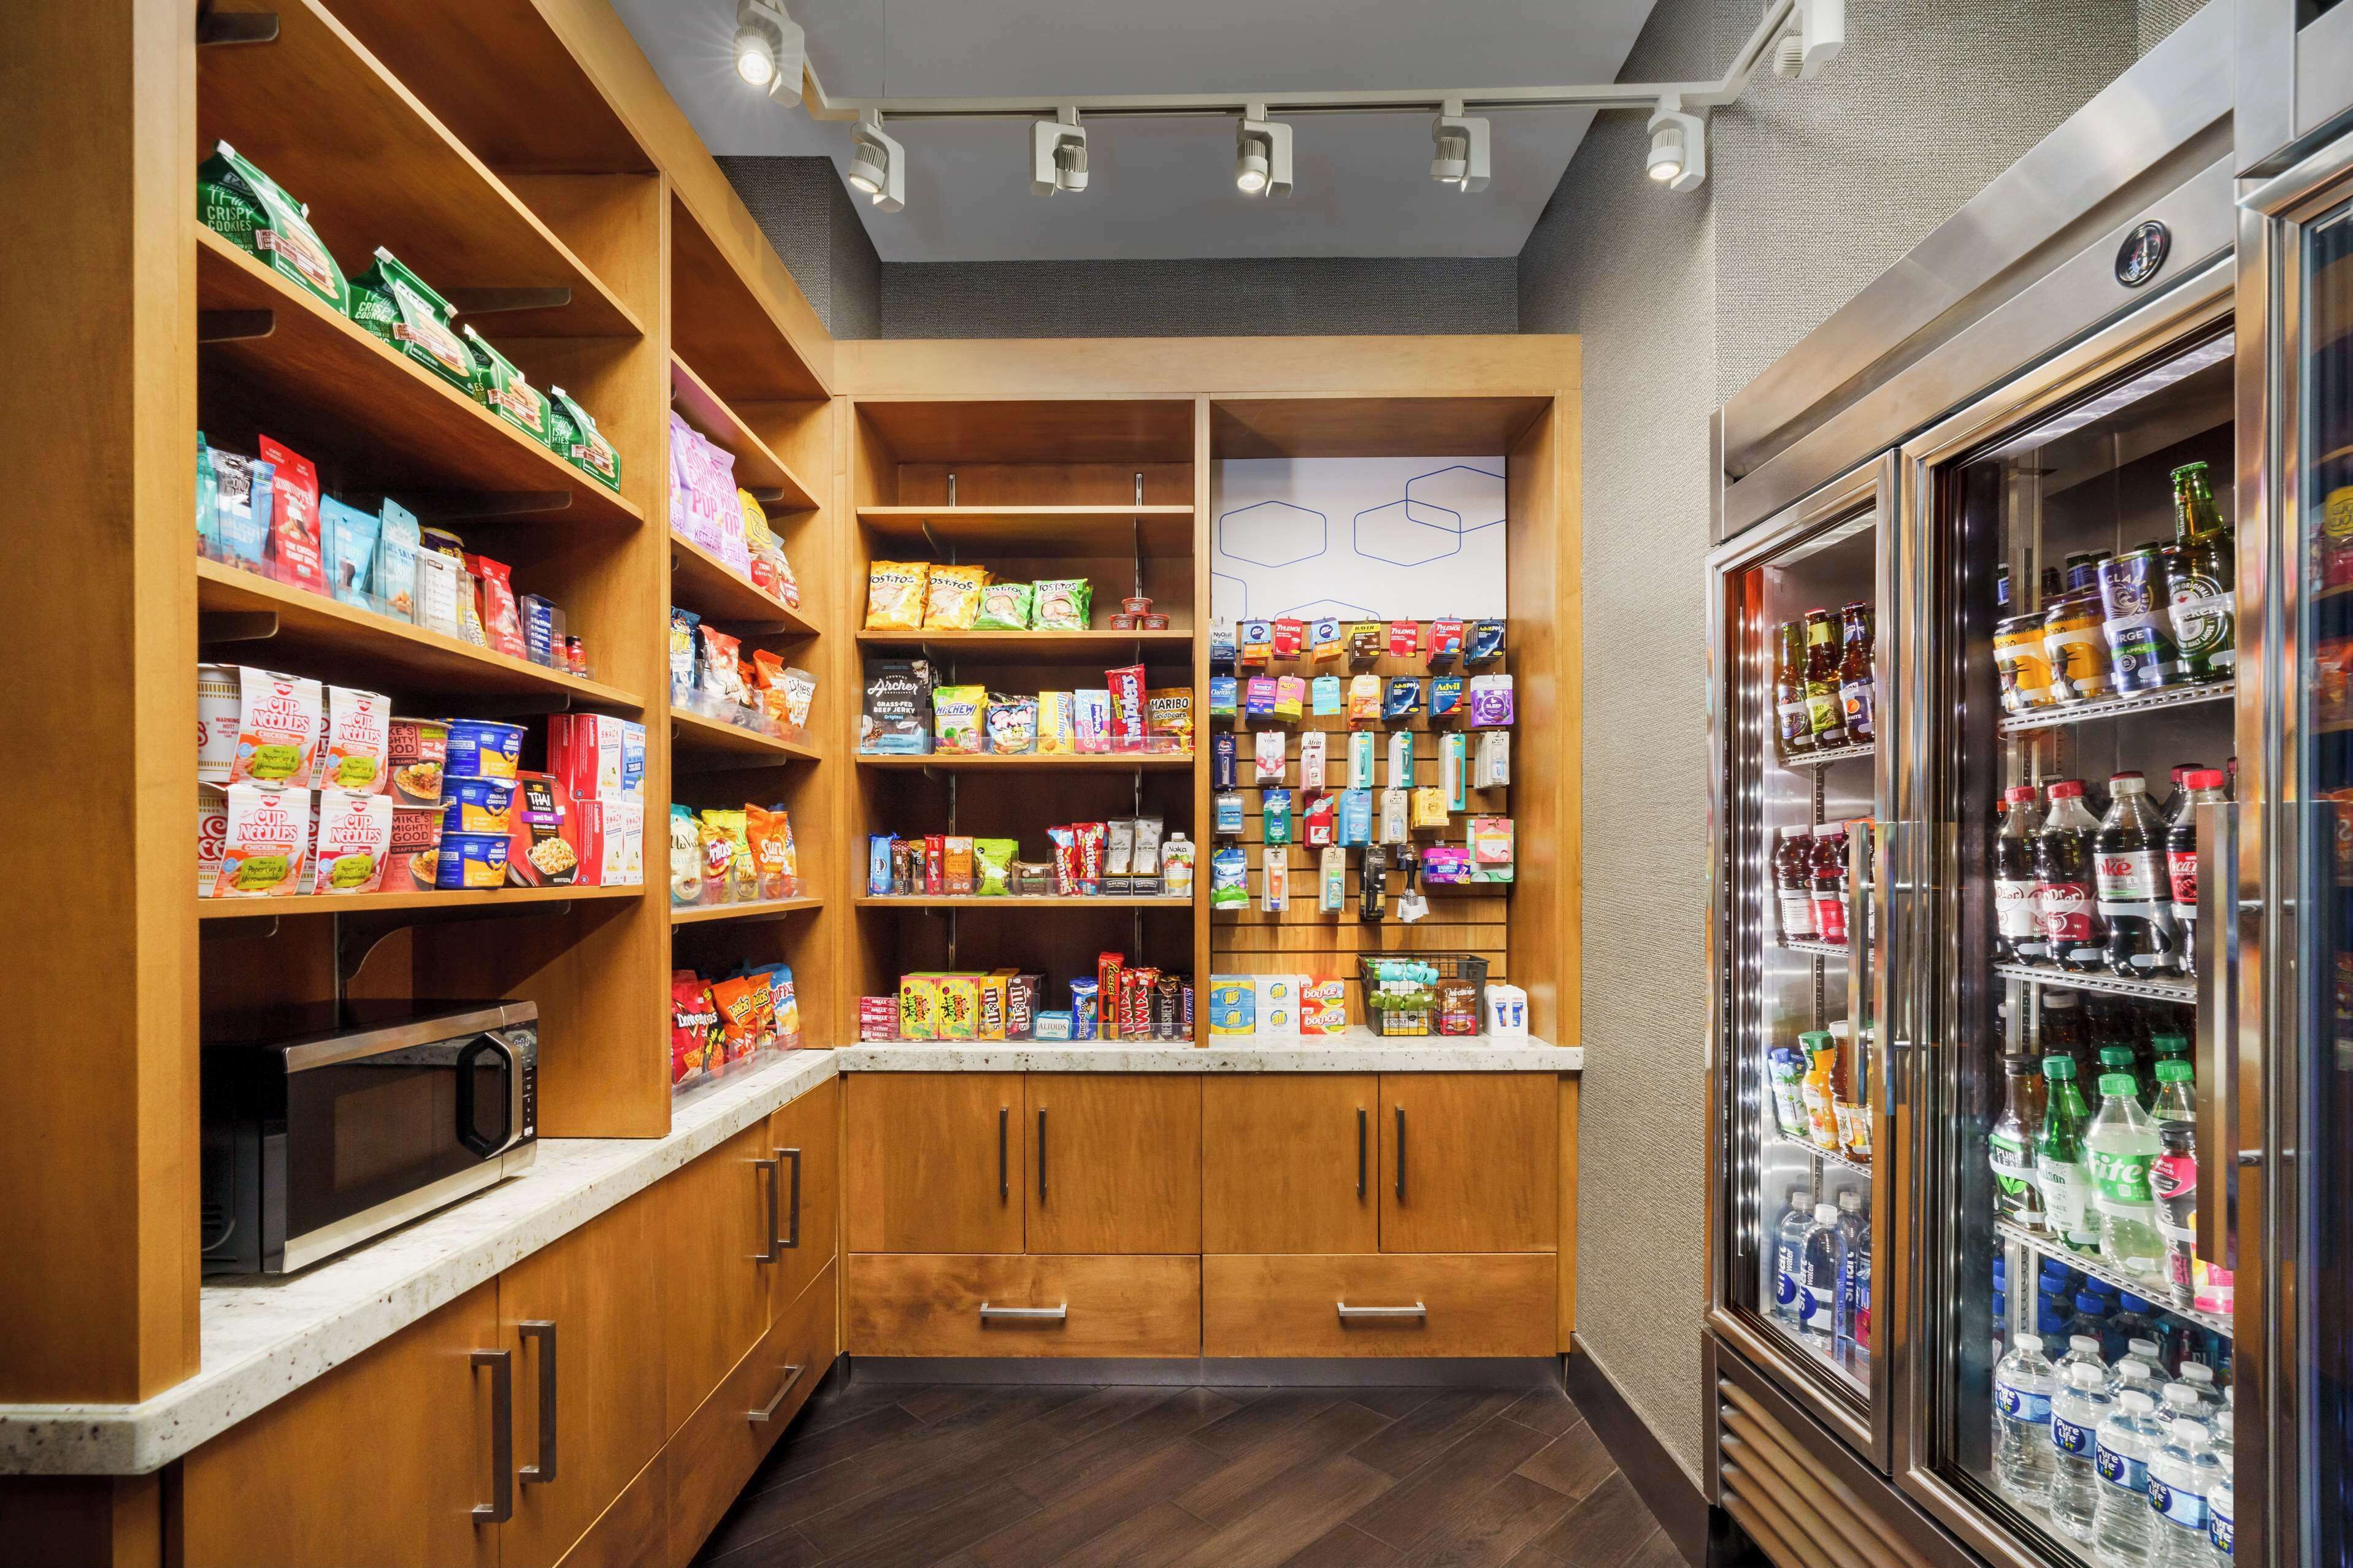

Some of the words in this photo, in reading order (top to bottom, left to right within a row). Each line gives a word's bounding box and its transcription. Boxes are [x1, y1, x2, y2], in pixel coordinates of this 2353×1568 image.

[206, 206, 255, 221] CRISPY
[208, 220, 252, 232] COOKIES
[355, 312, 394, 323] COOKIES
[358, 301, 399, 317] CRISPY
[1038, 582, 1078, 592] TOSTITOS
[2106, 573, 2146, 588] CLAW
[985, 586, 1023, 596] TOSTITOS
[2181, 583, 2211, 599] ORIGINAL
[2126, 646, 2148, 655] APPLE
[867, 678, 919, 697] Archer
[1436, 682, 1461, 691] Advil
[267, 696, 301, 716] CUP
[935, 704, 977, 716] HI-CHEW
[1120, 675, 1141, 747] Twizzlers
[1151, 697, 1189, 711] HARIBO
[250, 709, 310, 733] NOODLES
[351, 712, 374, 729] CUP
[1056, 692, 1068, 747] Butterfinger
[1094, 705, 1103, 732] Original
[258, 730, 290, 740] CHICKEN
[338, 724, 383, 746] NOODLES
[527, 792, 551, 807] THAI
[253, 808, 288, 827] CUP
[344, 813, 374, 830] CUP
[237, 823, 298, 843] NOODLES
[329, 827, 383, 844] NOODLES
[393, 824, 429, 833] MIGHTY
[393, 831, 429, 843] GOOD
[710, 841, 732, 863] Fritos
[759, 839, 786, 863] Sun
[1085, 832, 1097, 879] Skittles
[248, 865, 264, 875] Paper
[1108, 961, 1120, 995] Reese's
[1271, 984, 1286, 999] all
[1303, 987, 1338, 1000] bounce
[907, 996, 916, 1022] SOUR
[915, 995, 925, 1022] PATCH
[946, 996, 955, 1022] SOUR
[954, 995, 964, 1022] PATCH
[1121, 987, 1135, 1034] TWIX
[1135, 987, 1150, 1034] TWIX
[1185, 987, 1194, 1024] SNICKERS
[1161, 998, 1172, 1036] HERSHEY'S
[1226, 1011, 1242, 1025] all
[1271, 1011, 1286, 1025] all
[1305, 1013, 1339, 1026] bounce
[1038, 1022, 1067, 1031] ALTOIDS
[1786, 1249, 1794, 1272] water
[1806, 1261, 1815, 1287] water
[1998, 1383, 2016, 1399] Pure
[1998, 1392, 2014, 1406] Life
[2057, 1419, 2079, 1437] Pure
[2059, 1430, 2077, 1444] Life
[2098, 1447, 2119, 1464] Pure
[2098, 1457, 2116, 1471] Life
[2148, 1475, 2168, 1495] Pure
[2149, 1484, 2165, 1502] Life
[2211, 1512, 2233, 1532] Pure
[2212, 1523, 2232, 1542] Life
